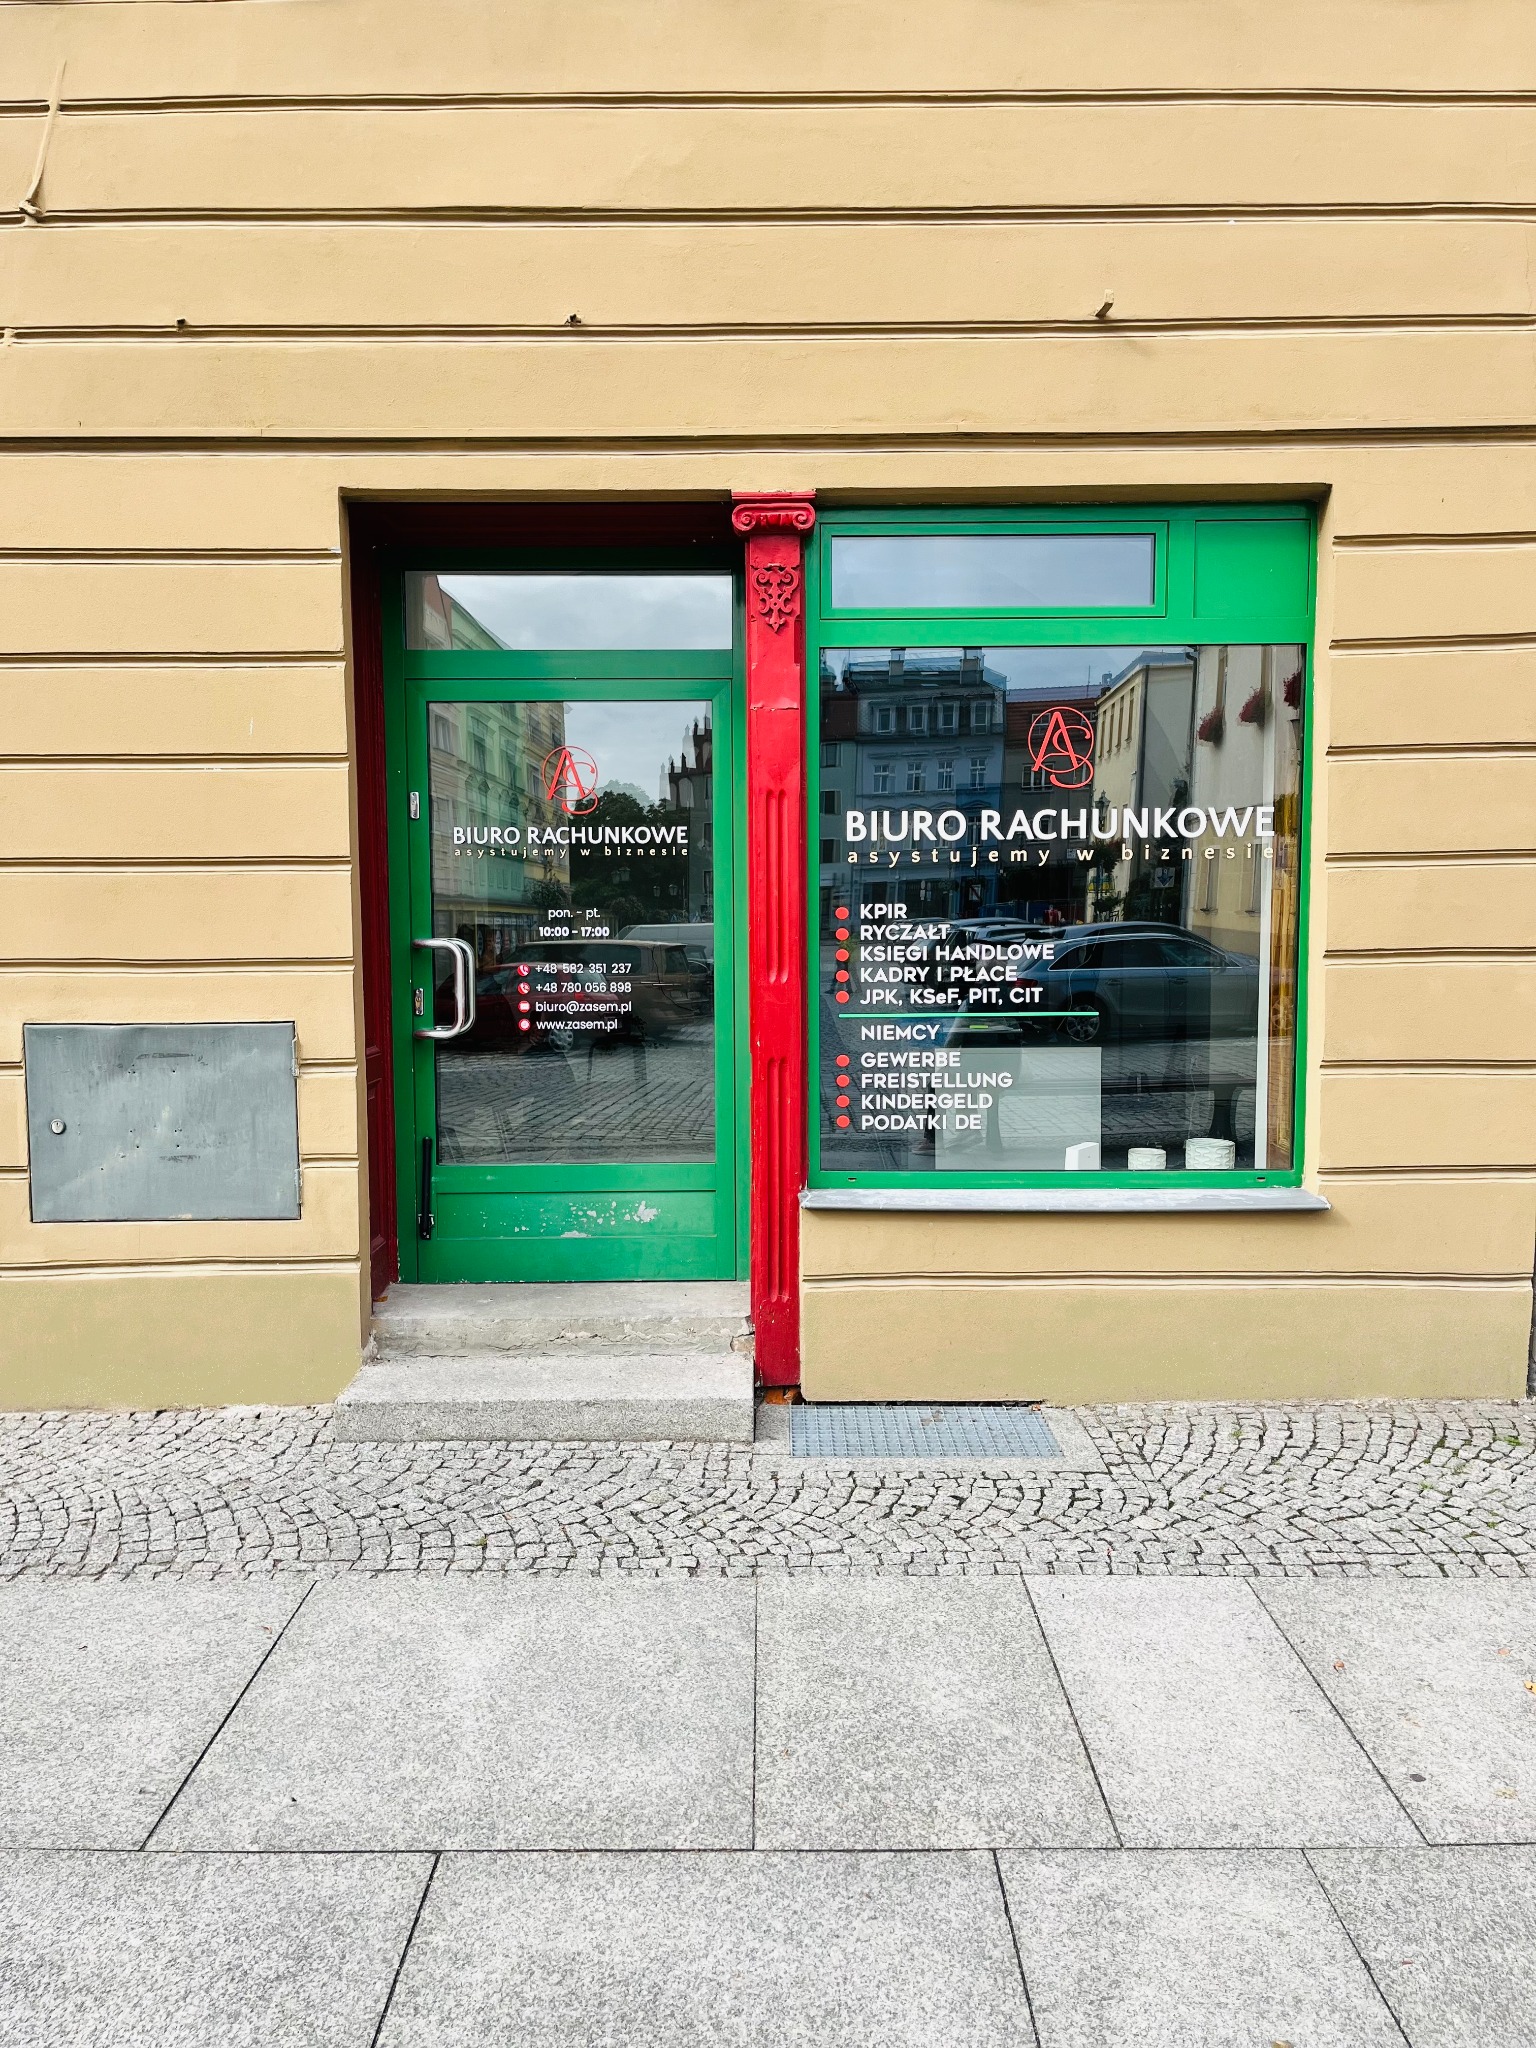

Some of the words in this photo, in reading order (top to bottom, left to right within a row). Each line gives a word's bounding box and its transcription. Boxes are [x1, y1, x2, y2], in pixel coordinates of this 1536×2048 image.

[845, 810, 966, 842] BIURO
[980, 807, 1275, 840] RACHUNKOWE
[453, 827, 520, 844] BIURO
[527, 826, 688, 844] RACHUNKOWE
[455, 848, 567, 858] asystujemy
[605, 846, 688, 856] biznesie
[848, 848, 1050, 867] asystujemy
[1078, 849, 1093, 861] w
[1122, 843, 1274, 860] biznesie
[548, 909, 573, 921] pon.
[586, 908, 600, 921] pt.
[860, 904, 907, 919] KPIR
[539, 927, 569, 937] 10:00
[581, 927, 609, 937] 17:00
[860, 925, 950, 940] RYCZAŁT
[860, 946, 927, 963] KSIĘGI
[936, 945, 1054, 960] HANDLOWE
[535, 964, 557, 974] +48
[562, 964, 583, 974] 582
[589, 964, 607, 973] 351
[612, 964, 631, 973] 237
[860, 967, 928, 982] KADRY
[937, 967, 941, 981] I
[950, 966, 1017, 982] PŁACE
[536, 983, 557, 993] +48
[561, 983, 581, 993] 780
[585, 983, 607, 993] 056
[610, 983, 631, 993] 898
[860, 989, 902, 1007] JPK,
[910, 989, 962, 1006] KSeF,
[969, 988, 1002, 1005] PIT,
[1009, 988, 1043, 1004] CIT
[535, 1001, 631, 1014] biuro@zasem.pl
[536, 1019, 617, 1032] www.zasem.pl
[861, 1025, 940, 1040] NIEMCY
[861, 1052, 960, 1067] GEWERBE
[861, 1073, 1013, 1088] FREISTELLUNG
[861, 1094, 992, 1109] KINDERGELD
[861, 1115, 947, 1130] PODATKI
[955, 1114, 982, 1129] DE
